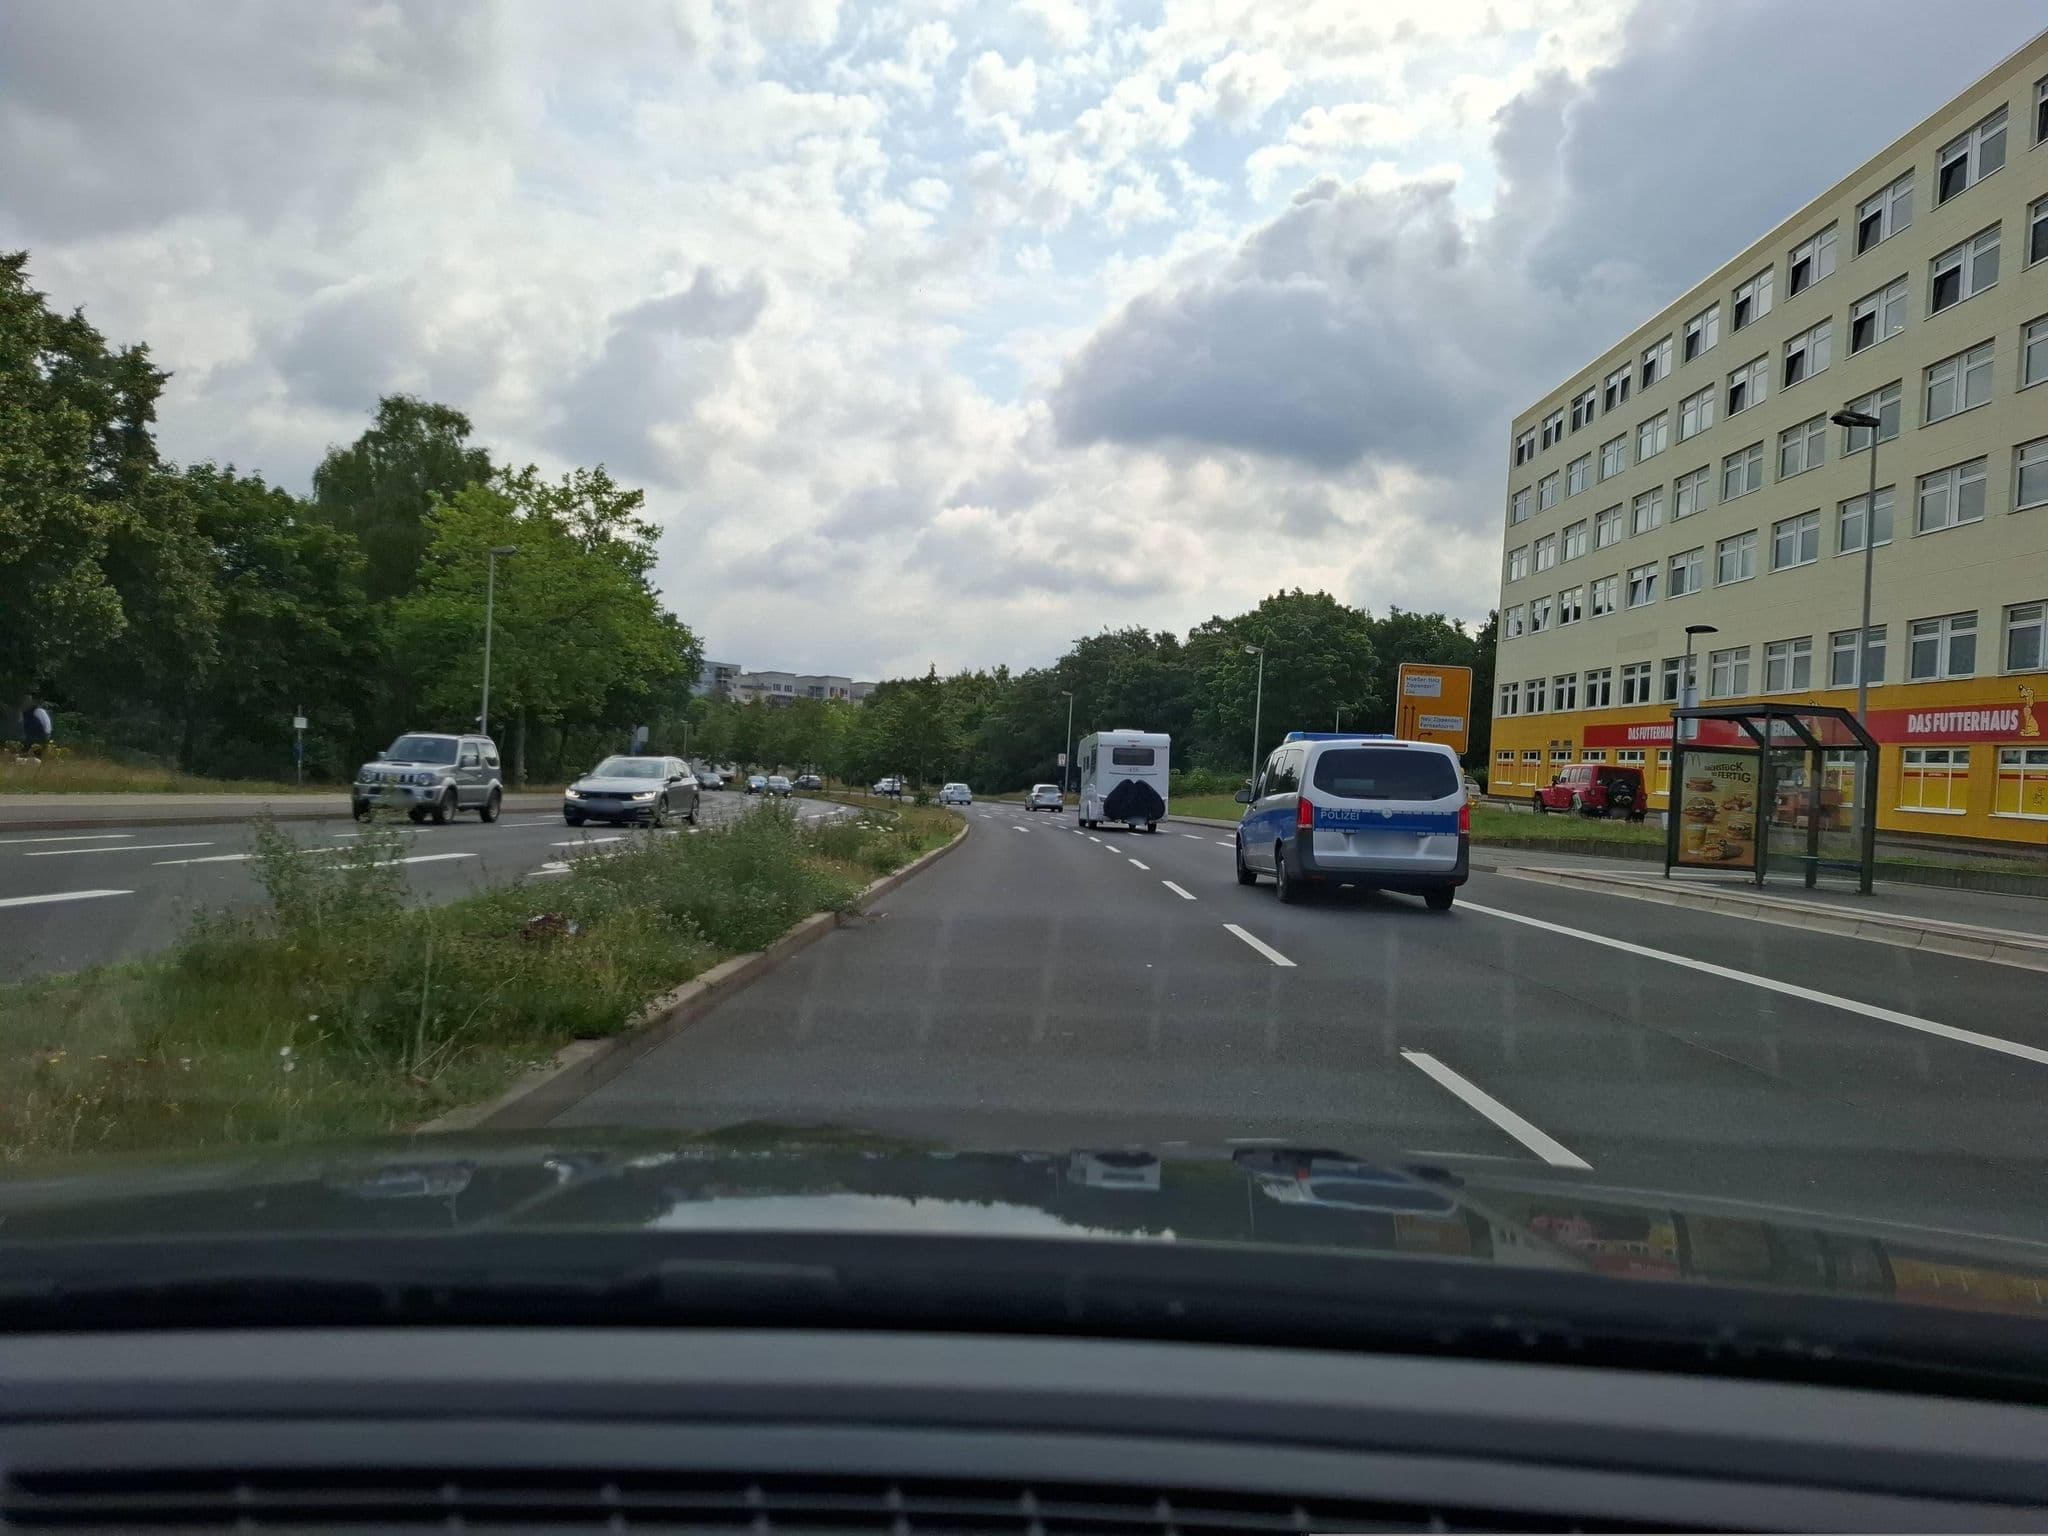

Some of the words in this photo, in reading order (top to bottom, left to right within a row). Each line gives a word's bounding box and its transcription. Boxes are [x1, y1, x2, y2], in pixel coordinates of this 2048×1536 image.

[1908, 714, 1932, 733] DAS
[1934, 710, 2019, 732] FUTTERHAUS
[1628, 727, 1639, 740] DAS
[1640, 725, 1674, 740] FUTTERHAU
[1718, 771, 1751, 783] FERTIG
[1320, 811, 1360, 820] POLIZEI
